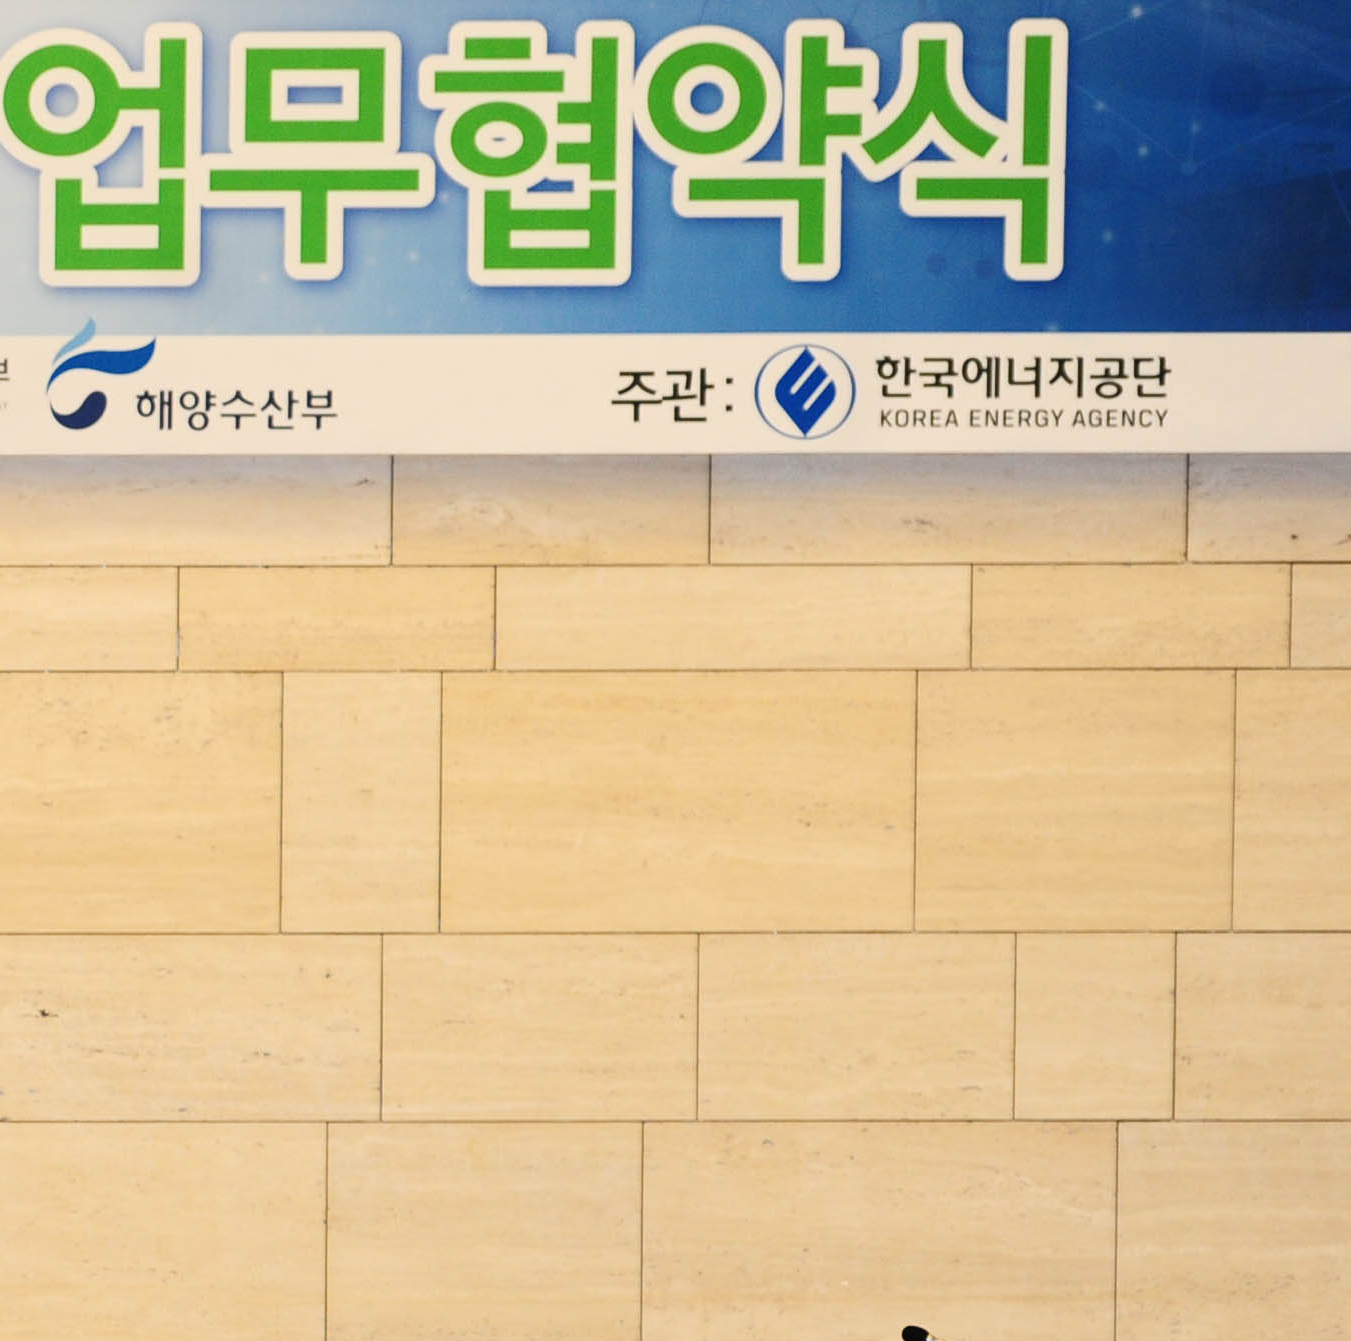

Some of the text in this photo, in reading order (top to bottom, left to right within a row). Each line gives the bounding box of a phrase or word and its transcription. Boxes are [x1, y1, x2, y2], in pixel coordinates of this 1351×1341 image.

[2, 33, 1057, 271] 업무협약식
[874, 354, 1173, 401] 한국에너지공단
[135, 388, 339, 432] 해양수산부
[879, 408, 1169, 429] KOREA ENERGY AGENCY
